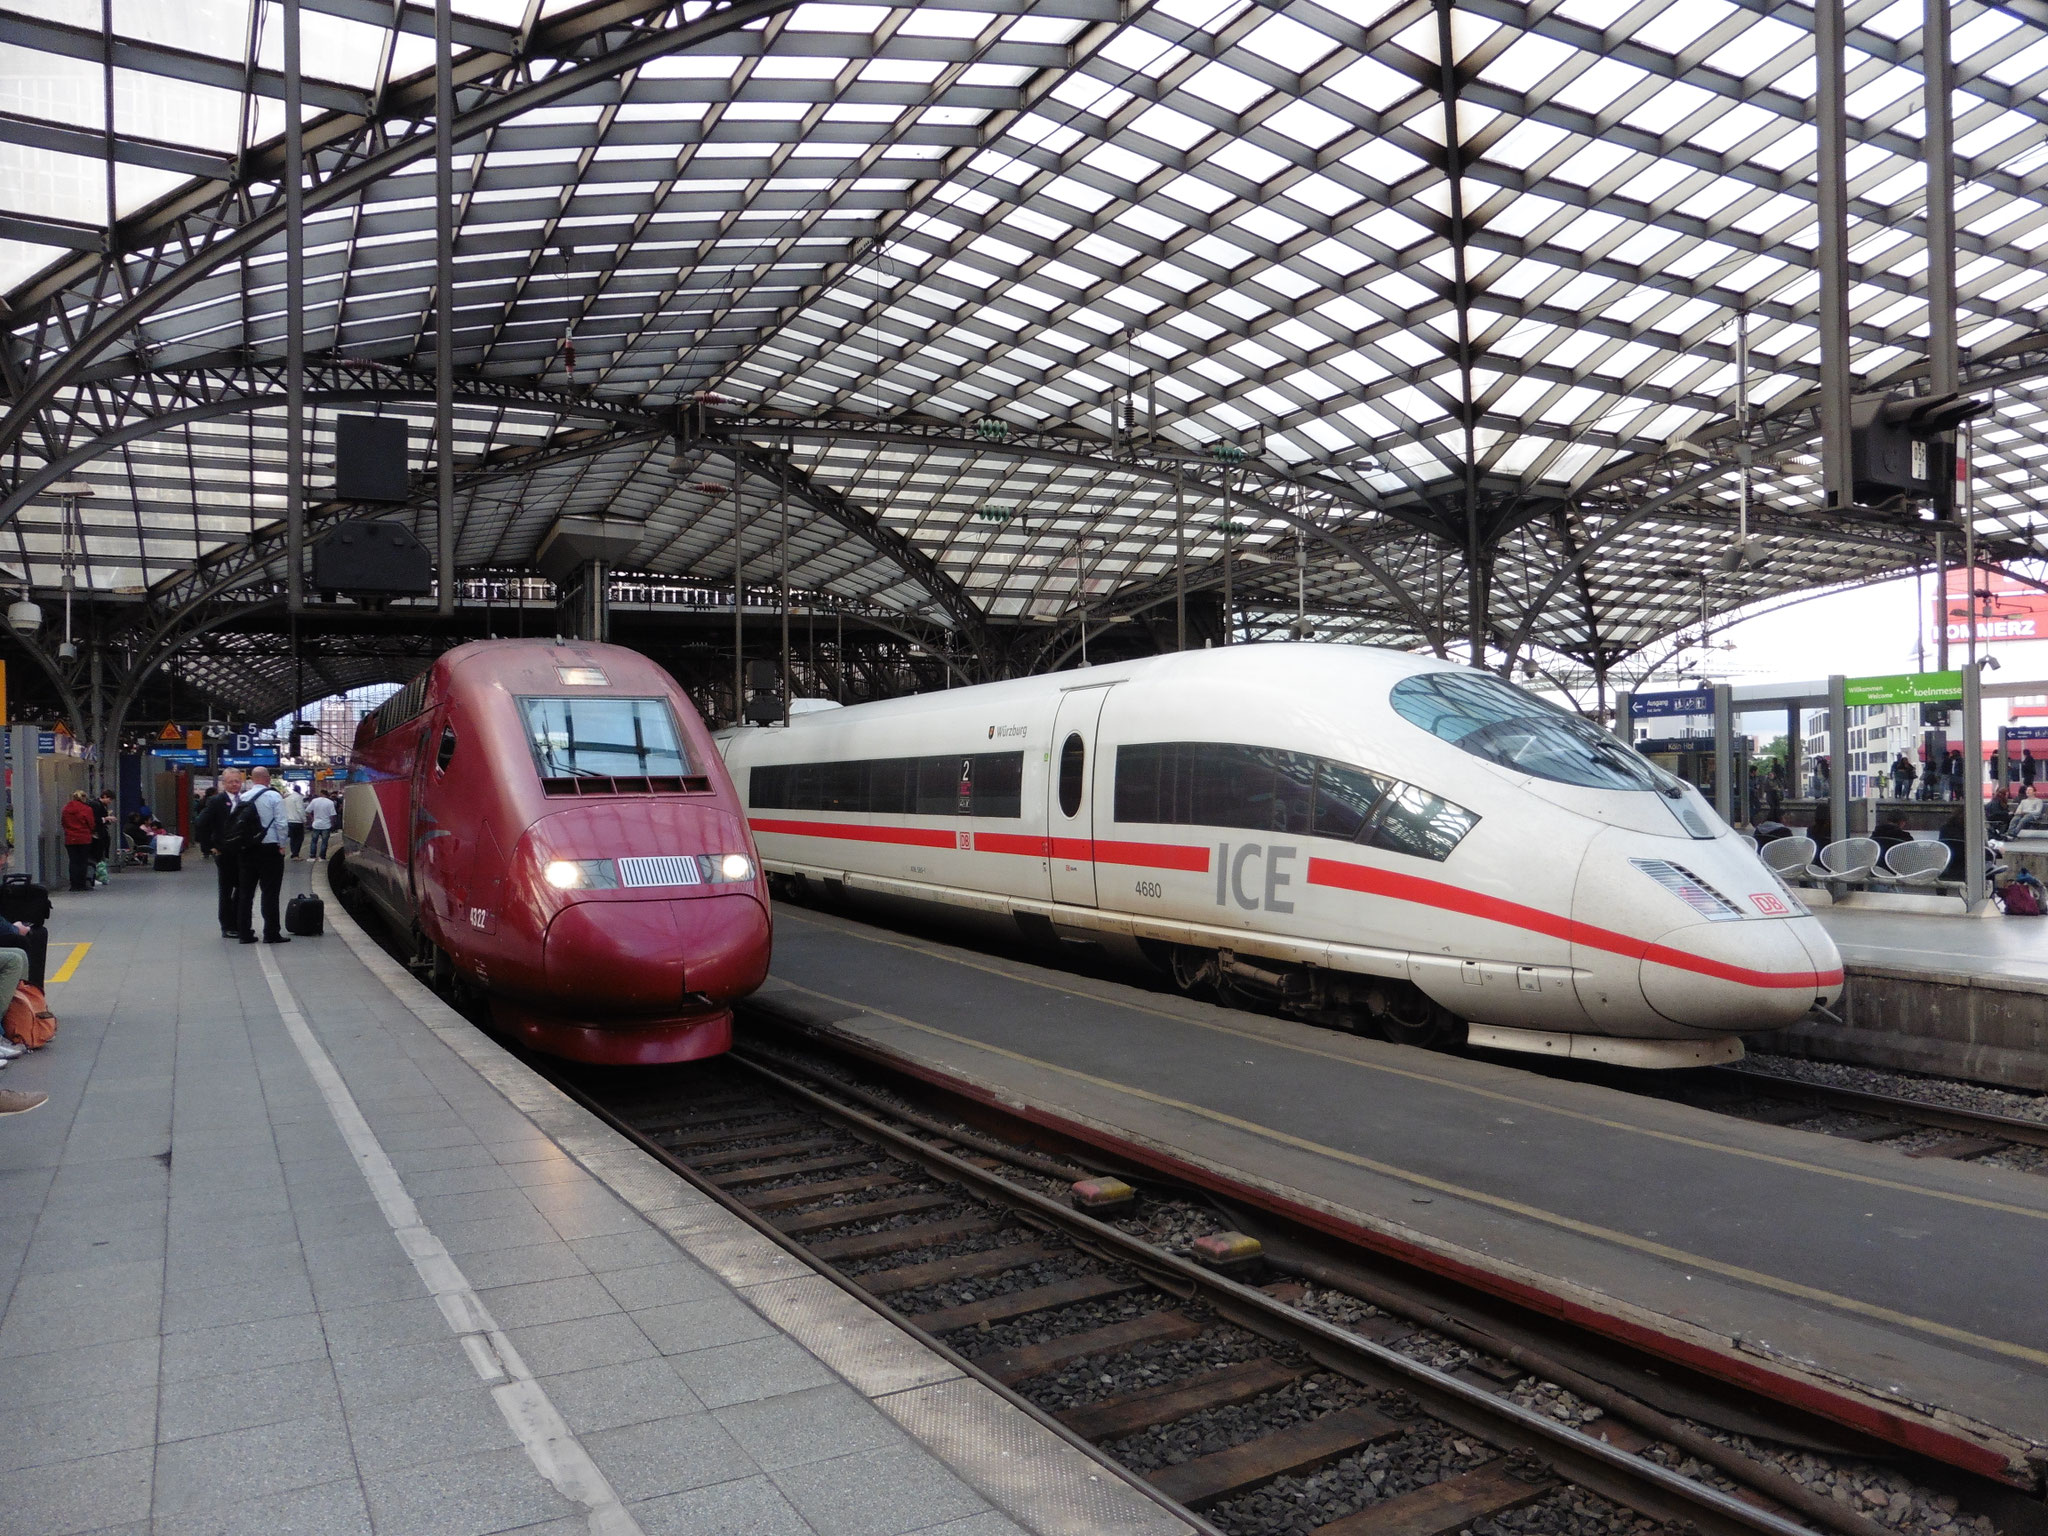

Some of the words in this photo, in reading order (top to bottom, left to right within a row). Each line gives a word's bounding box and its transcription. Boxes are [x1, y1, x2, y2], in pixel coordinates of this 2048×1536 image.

[1913, 687, 1962, 697] koelnmesse
[1647, 699, 1669, 707] Ausgang
[248, 723, 257, 735] 5
[997, 724, 1028, 738] Würzburg
[236, 734, 251, 751] B
[335, 755, 343, 764] C
[962, 760, 970, 781] 2
[960, 833, 970, 848] DB
[1216, 843, 1297, 914] ICE
[1135, 881, 1162, 899] 4680
[1753, 895, 1784, 911] DB
[470, 907, 486, 928] 4322
